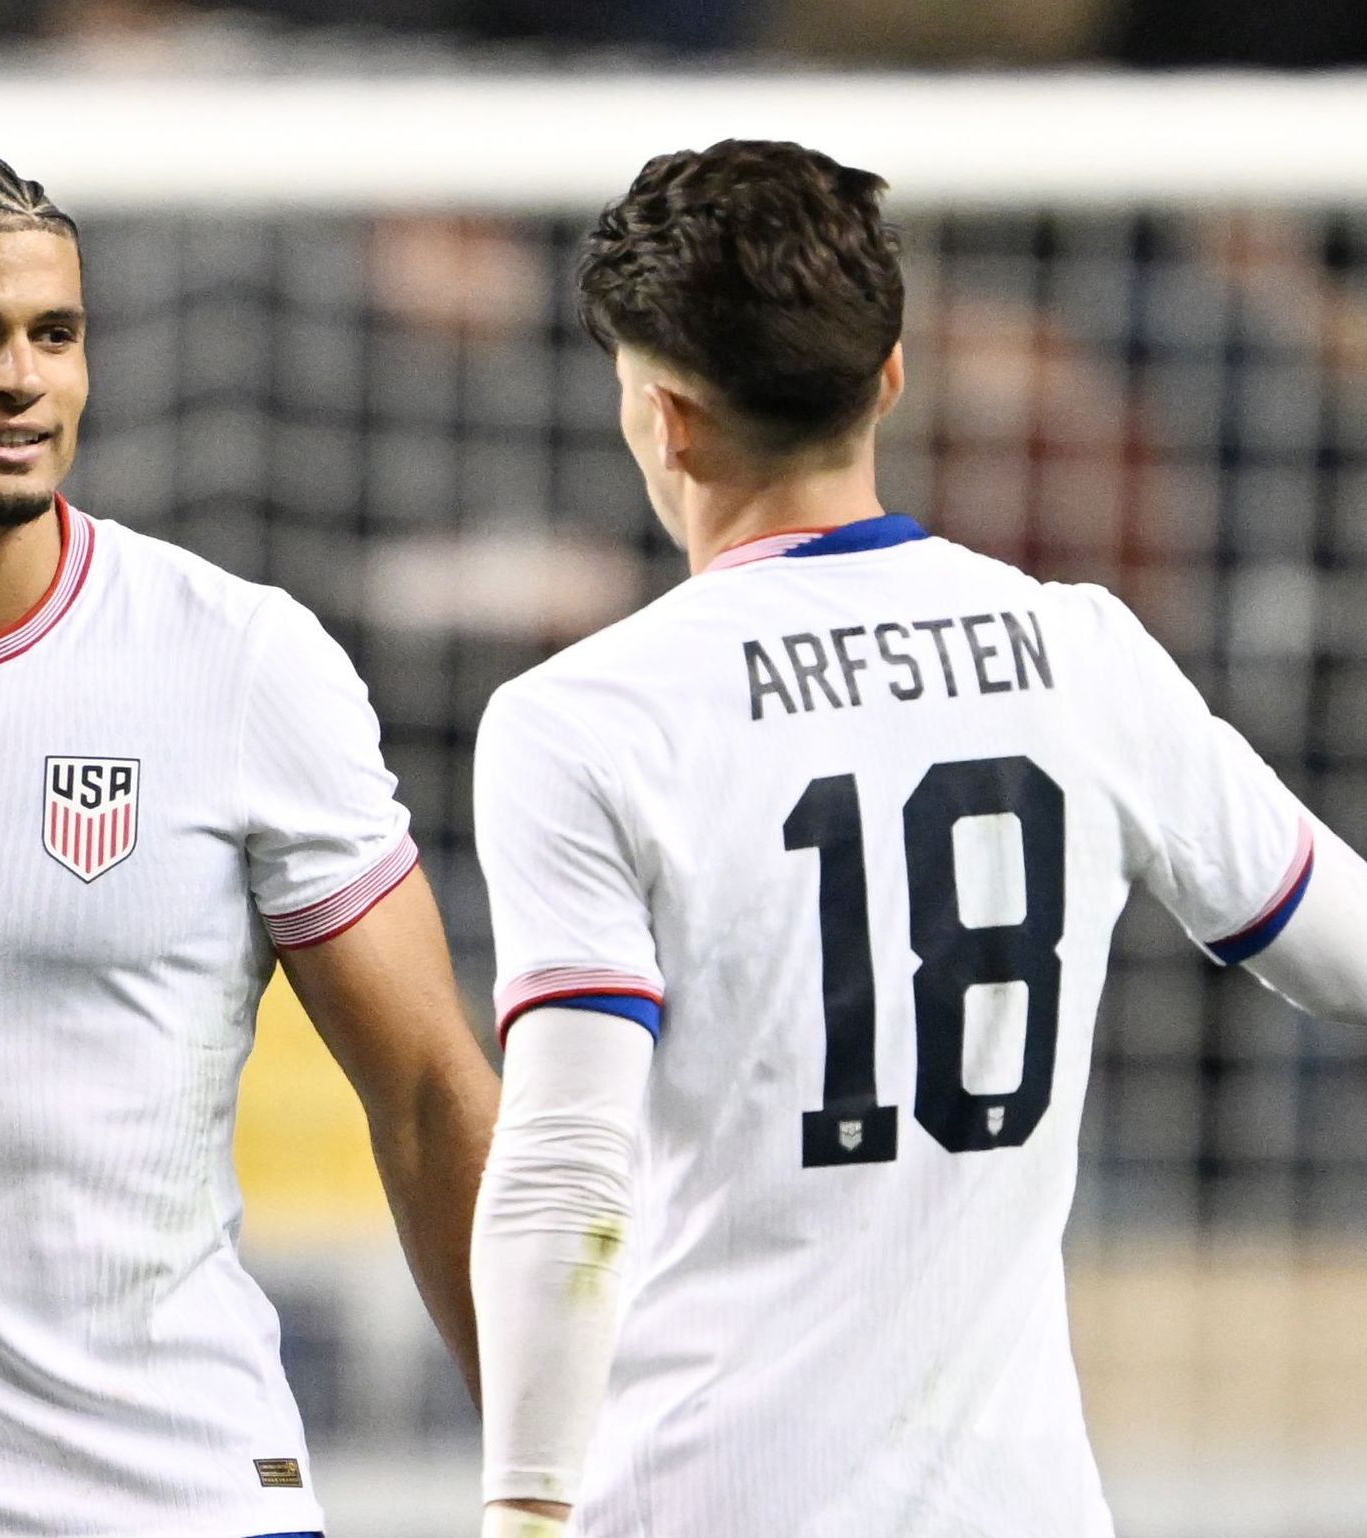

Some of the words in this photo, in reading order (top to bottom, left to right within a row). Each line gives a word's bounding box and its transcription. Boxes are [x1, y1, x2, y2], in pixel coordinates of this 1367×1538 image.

[742, 611, 1054, 721] ARFSTEN
[52, 764, 132, 809] USA
[782, 755, 1065, 1168] 18
